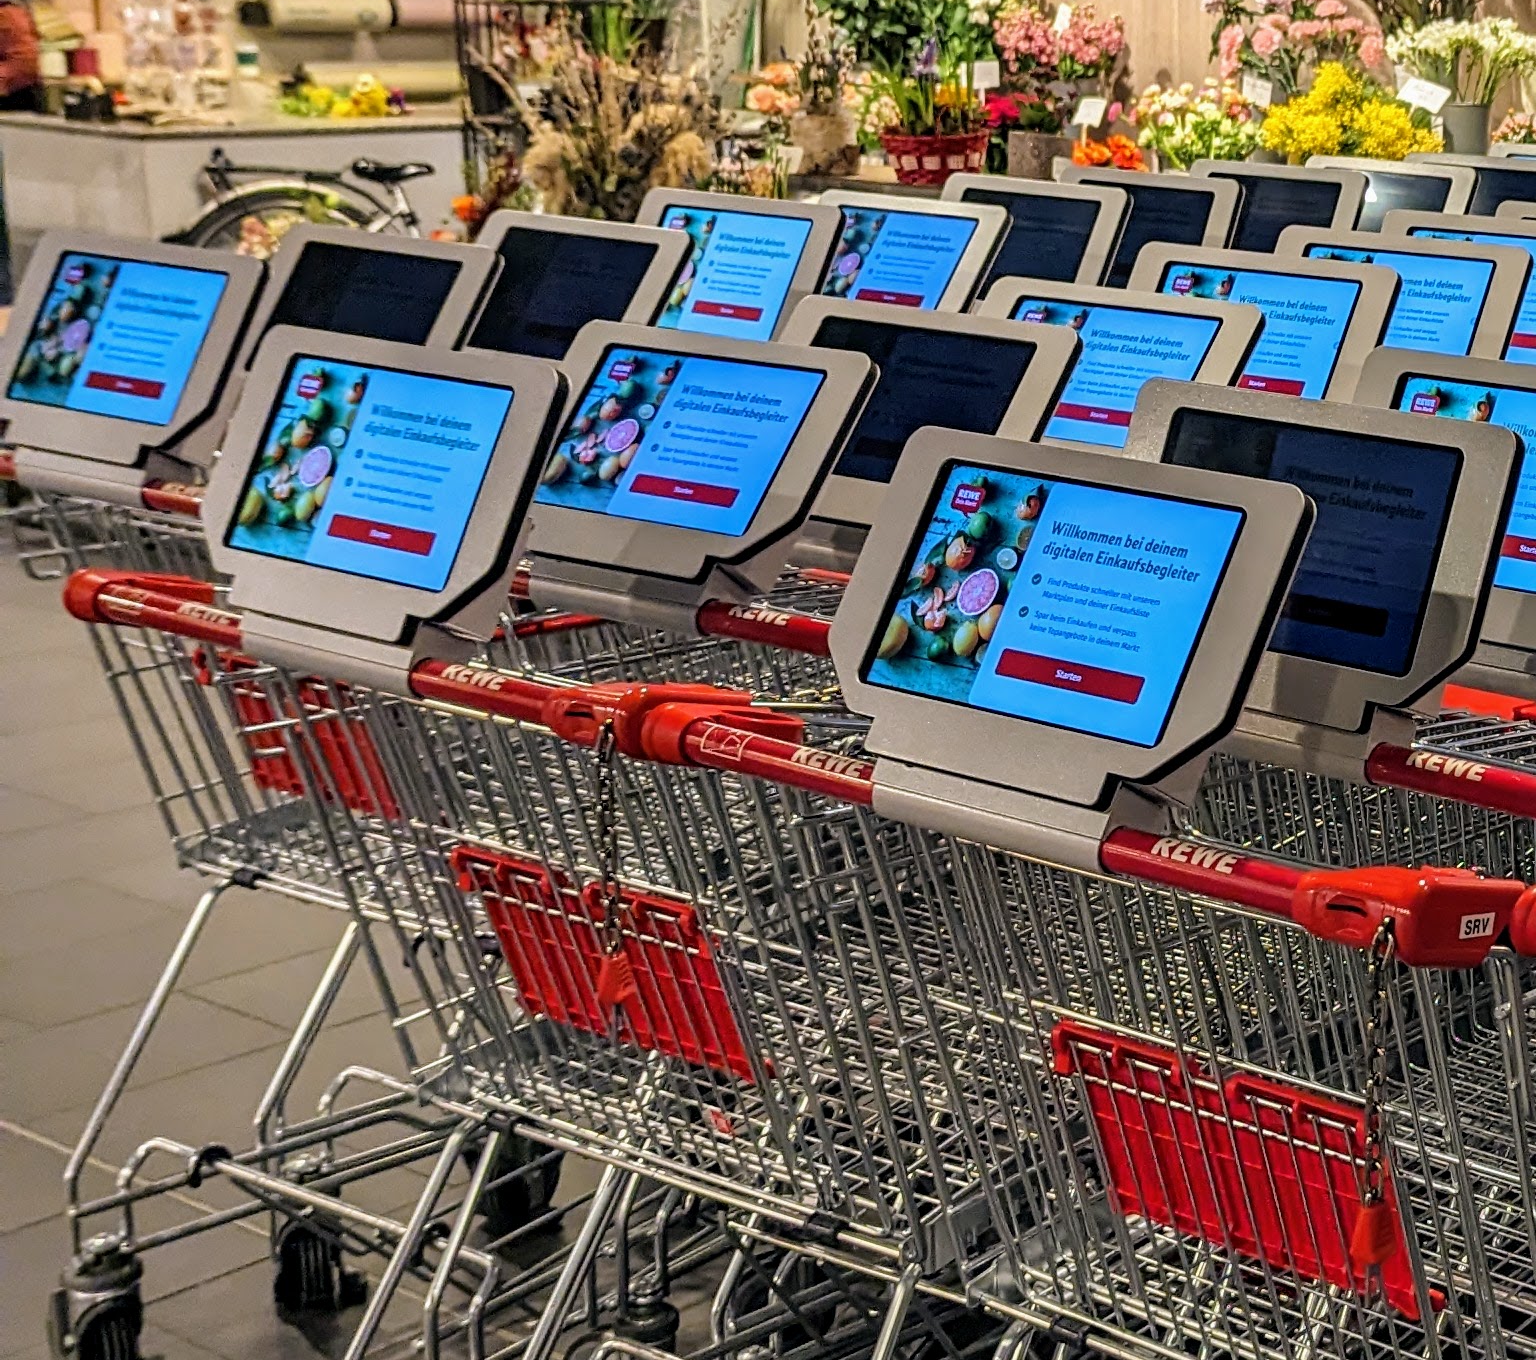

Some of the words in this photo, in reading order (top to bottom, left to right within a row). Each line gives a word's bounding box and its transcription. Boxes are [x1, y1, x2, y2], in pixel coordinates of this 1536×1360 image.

[1052, 520, 1122, 548] Willkommen
[1124, 535, 1145, 549] bei
[1145, 539, 1188, 558] deinem
[1042, 541, 1093, 563] digitalen
[1095, 551, 1200, 582] Einkaufsbegleiter
[791, 746, 864, 778] REWE
[1405, 748, 1487, 782] REWE
[1150, 837, 1241, 875] REWE
[1464, 917, 1490, 935] SRV
